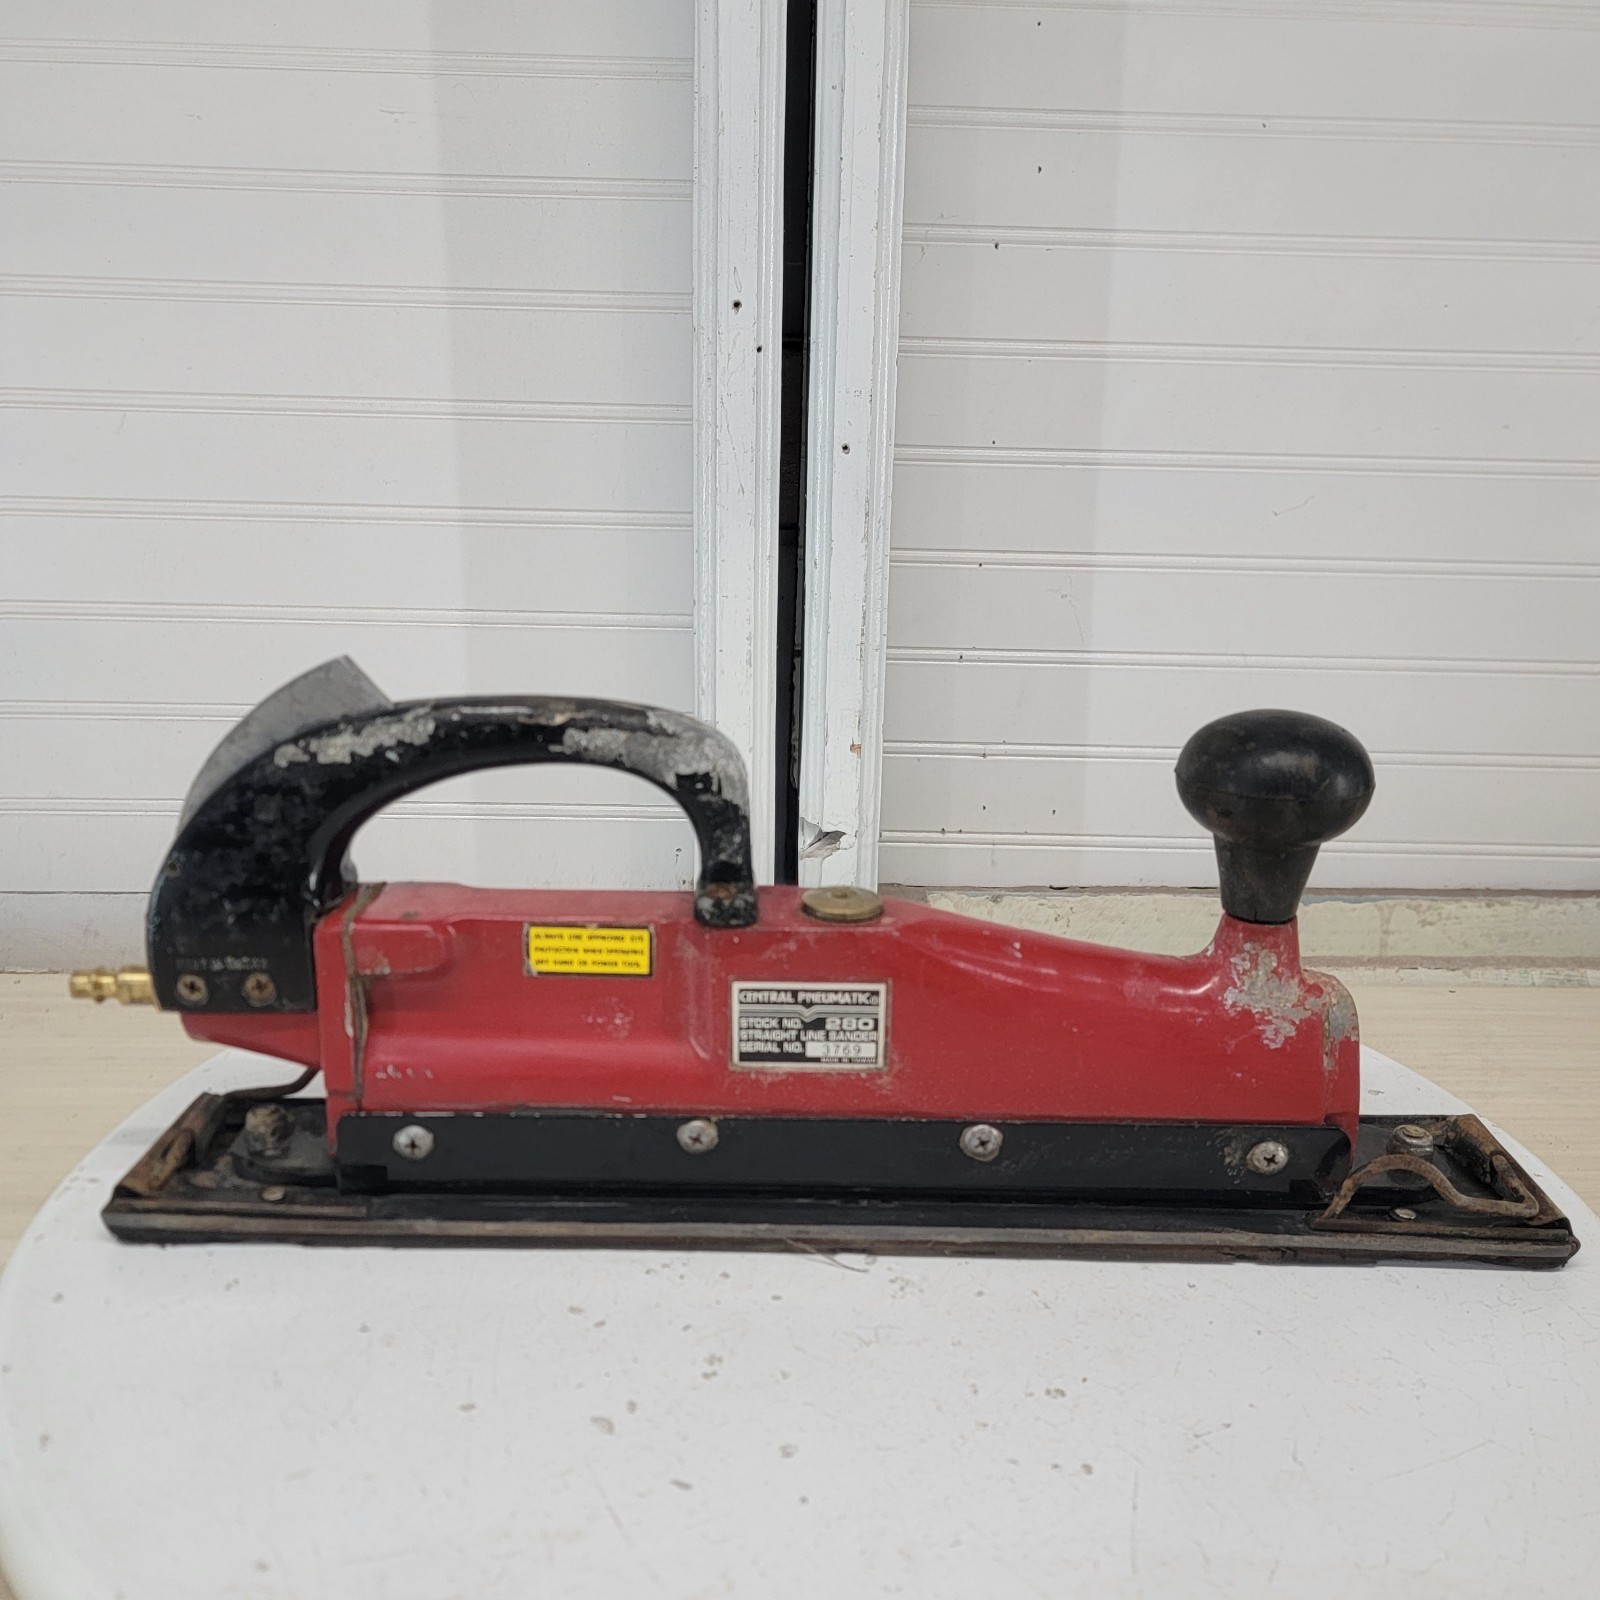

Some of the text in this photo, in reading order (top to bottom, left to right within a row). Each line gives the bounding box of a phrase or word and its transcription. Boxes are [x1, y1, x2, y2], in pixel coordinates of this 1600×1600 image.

[739, 990, 795, 1004] CENTRAL
[740, 1017, 779, 1029] STOCK
[781, 1018, 804, 1029] NO.
[740, 1029, 877, 1042] STRAIGHT LINE SANDER
[740, 1041, 781, 1053] SERIAL
[782, 1042, 804, 1053] NO.
